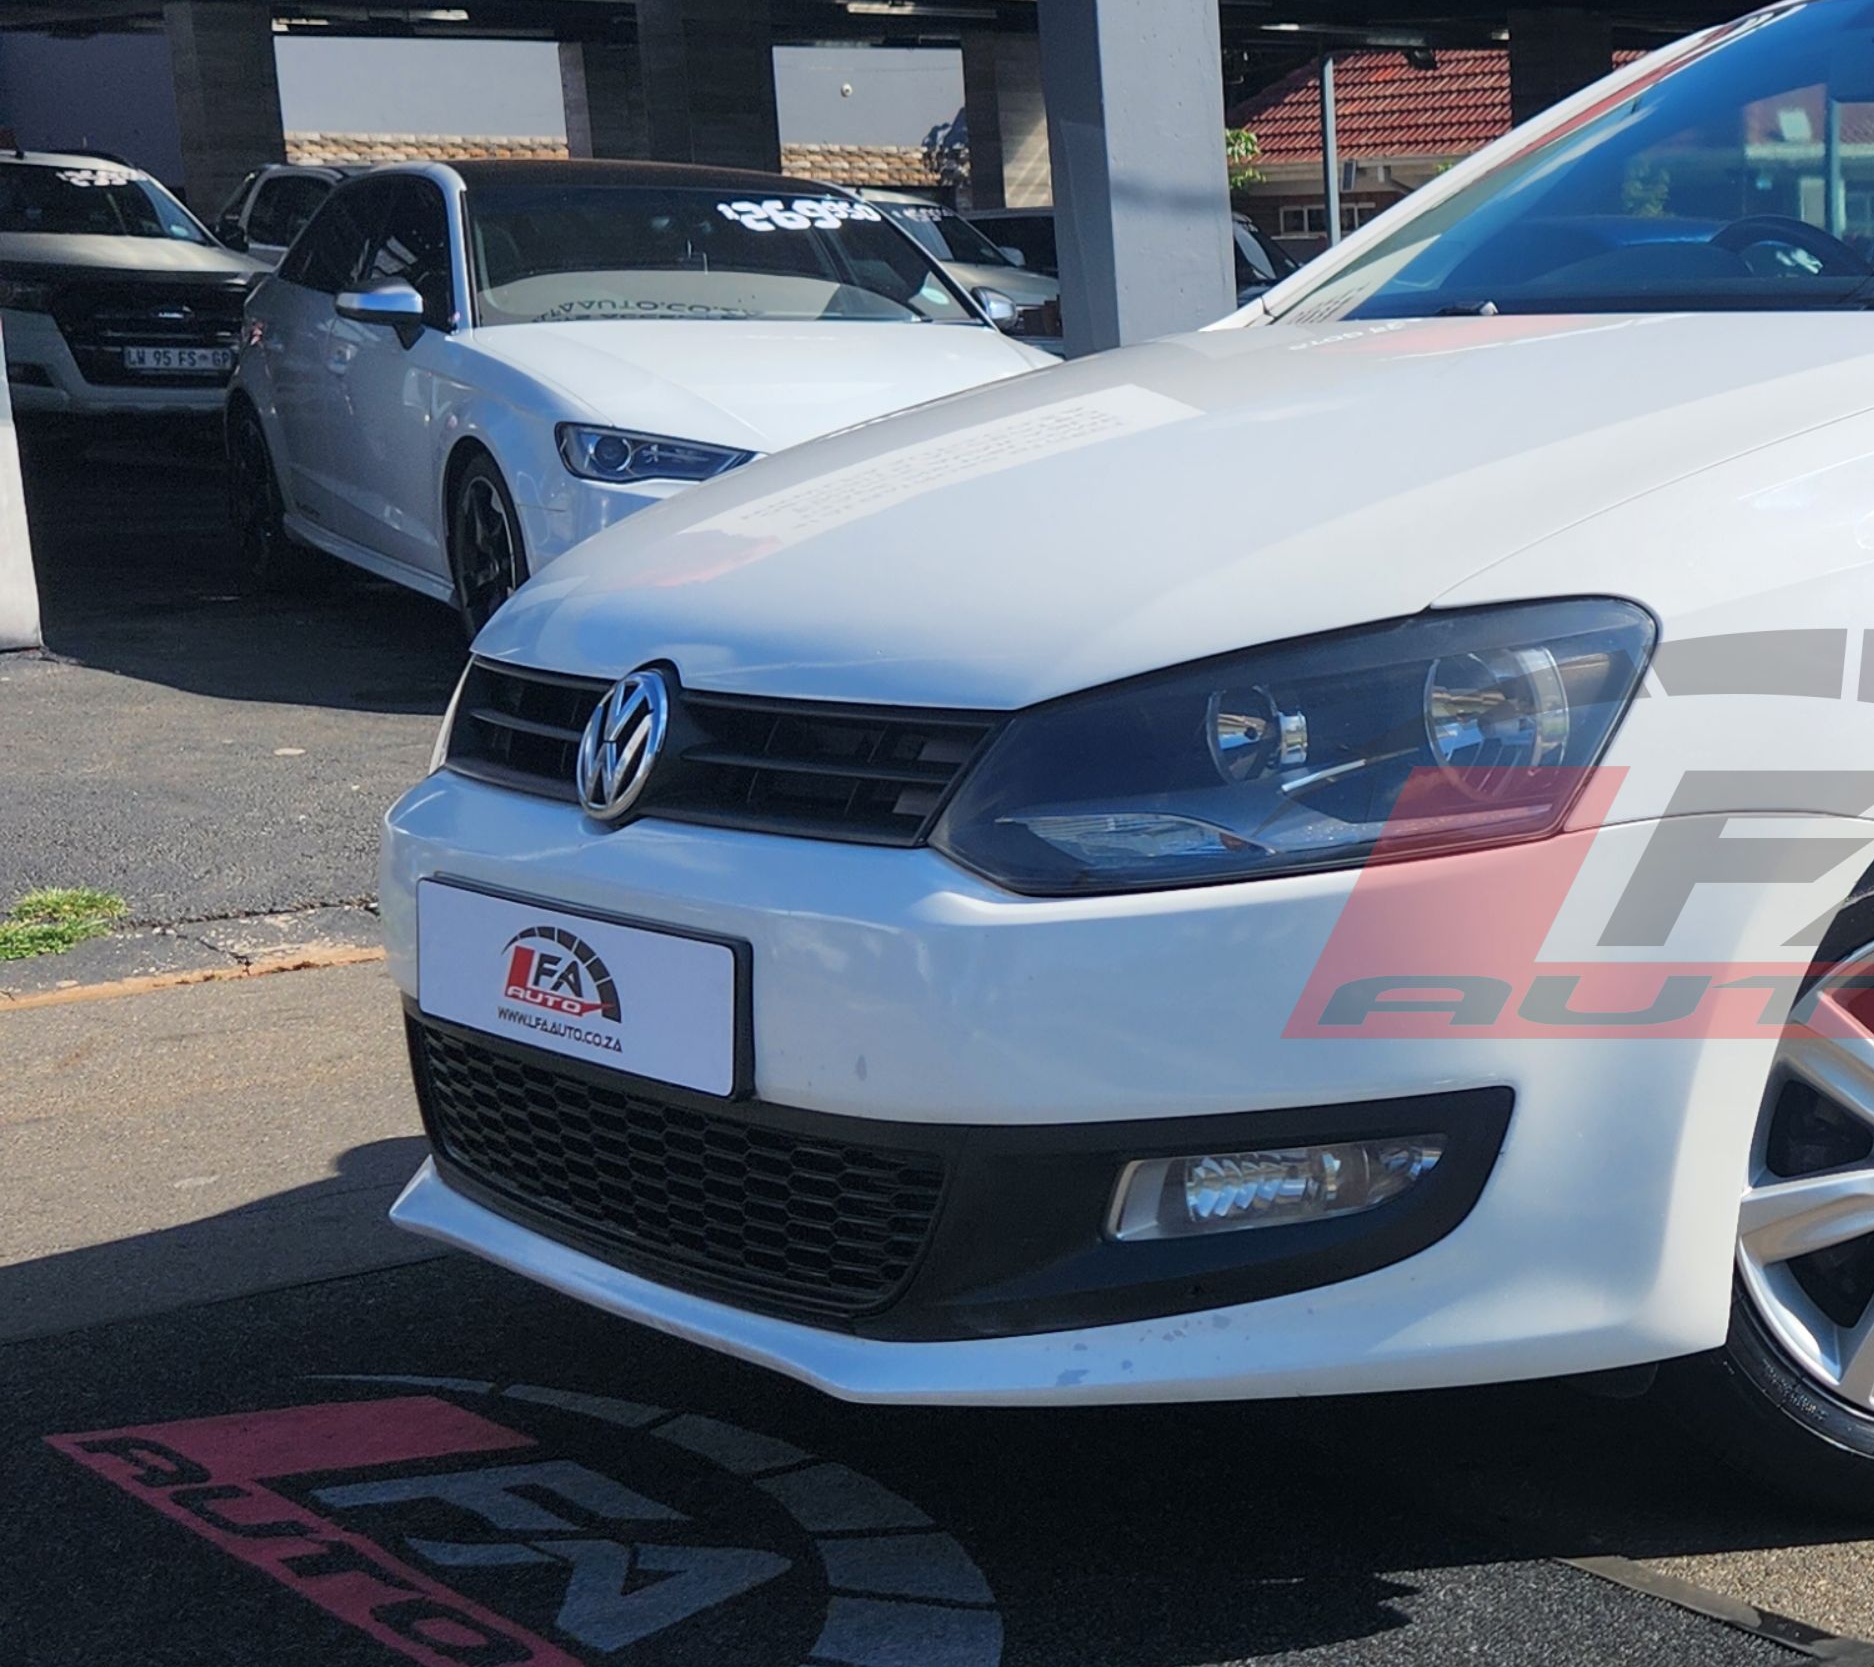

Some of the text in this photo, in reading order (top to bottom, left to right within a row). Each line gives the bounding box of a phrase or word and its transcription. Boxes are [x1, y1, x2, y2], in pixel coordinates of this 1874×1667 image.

[153, 350, 173, 367] 95
[504, 945, 584, 999] LFA
[507, 986, 581, 1014] AUTO
[497, 1005, 623, 1054] WWW.LFAAUTO.CO.ZA
[75, 1437, 534, 1667] AUTO
